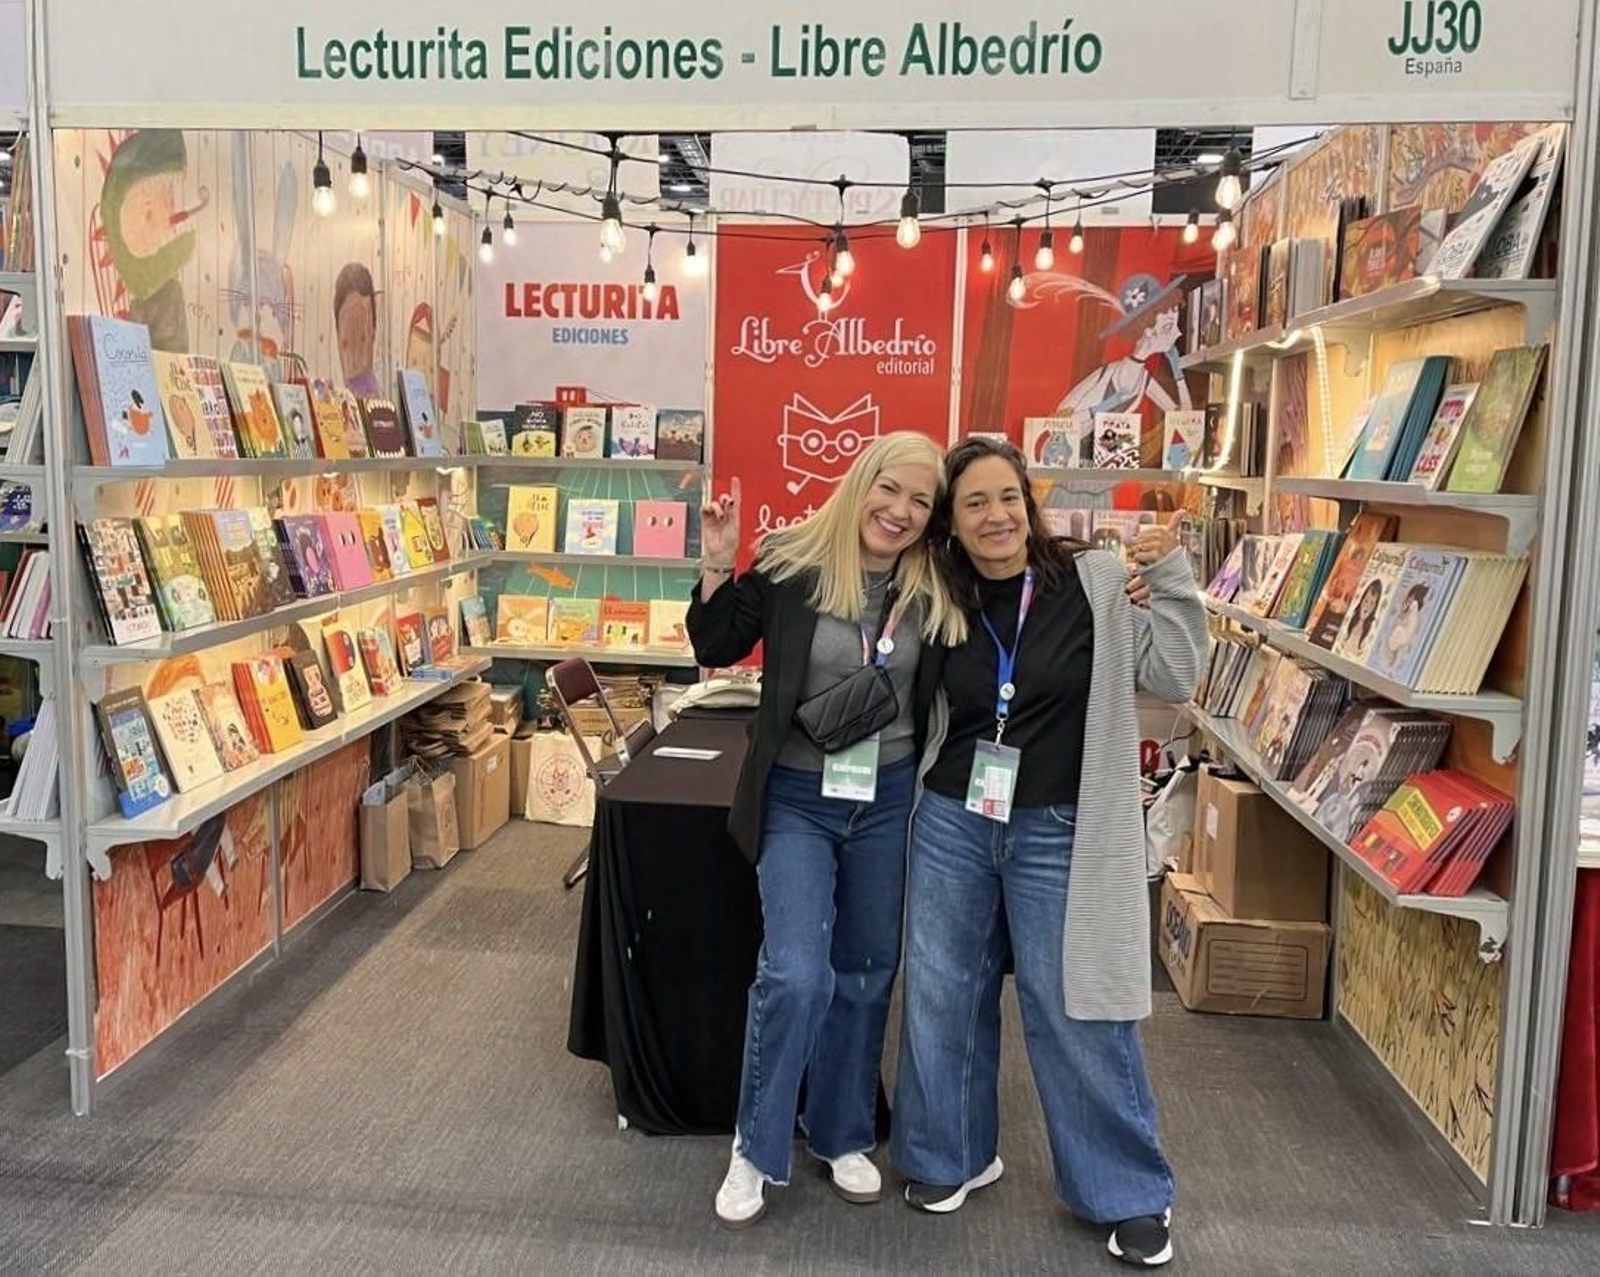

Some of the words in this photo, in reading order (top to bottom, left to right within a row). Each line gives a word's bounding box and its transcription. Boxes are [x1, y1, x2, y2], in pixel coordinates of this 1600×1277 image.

[1388, 0, 1482, 55] JJ30
[297, 26, 488, 80] Lecturita
[505, 26, 724, 80] Ediciones
[741, 53, 755, 64] -
[771, 24, 886, 78] Libre
[899, 18, 1103, 76] Albedrío
[1404, 57, 1463, 79] España
[505, 282, 681, 320] LECTURITA
[551, 326, 629, 345] EDICIONES
[731, 315, 803, 364] Libre
[876, 357, 935, 376] editorial
